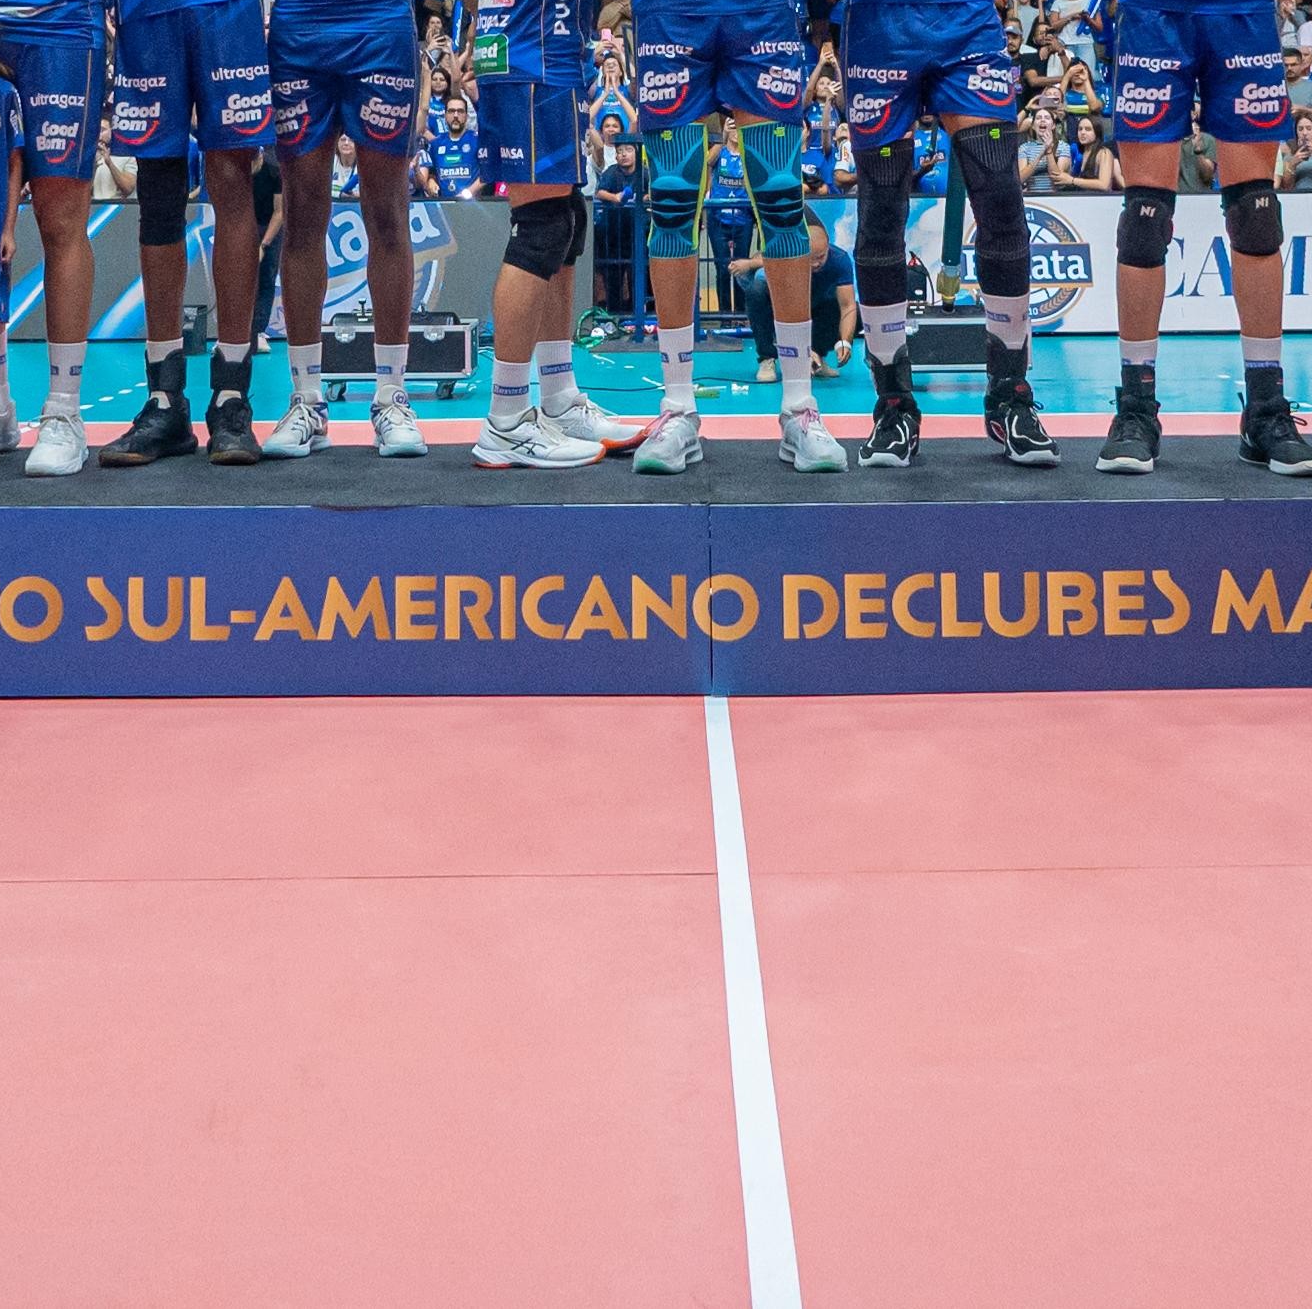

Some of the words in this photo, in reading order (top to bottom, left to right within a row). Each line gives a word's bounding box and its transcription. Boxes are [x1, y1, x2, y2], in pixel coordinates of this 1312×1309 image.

[1118, 53, 1181, 72] ultragaz
[1225, 53, 1282, 69] ultragaz
[211, 64, 270, 82] ultragaz
[643, 69, 690, 87] Good
[847, 64, 908, 84] ultragaz
[757, 73, 796, 96] Bom
[967, 75, 1009, 95] Bom
[1123, 83, 1172, 101] Good
[1243, 80, 1287, 100] Good
[30, 93, 85, 108] ultragaz
[228, 90, 272, 110] Good
[639, 87, 676, 103] Bom
[116, 102, 161, 118] Good
[368, 97, 410, 121] Good
[1115, 95, 1155, 114] Bom
[1234, 98, 1280, 114] Bom
[221, 109, 262, 126] Bom
[360, 104, 397, 130] Bom
[42, 121, 80, 137] Good
[36, 136, 67, 152] Bom
[963, 248, 1088, 281] Rata
[84, 573, 760, 643] SUL-AMERICANO
